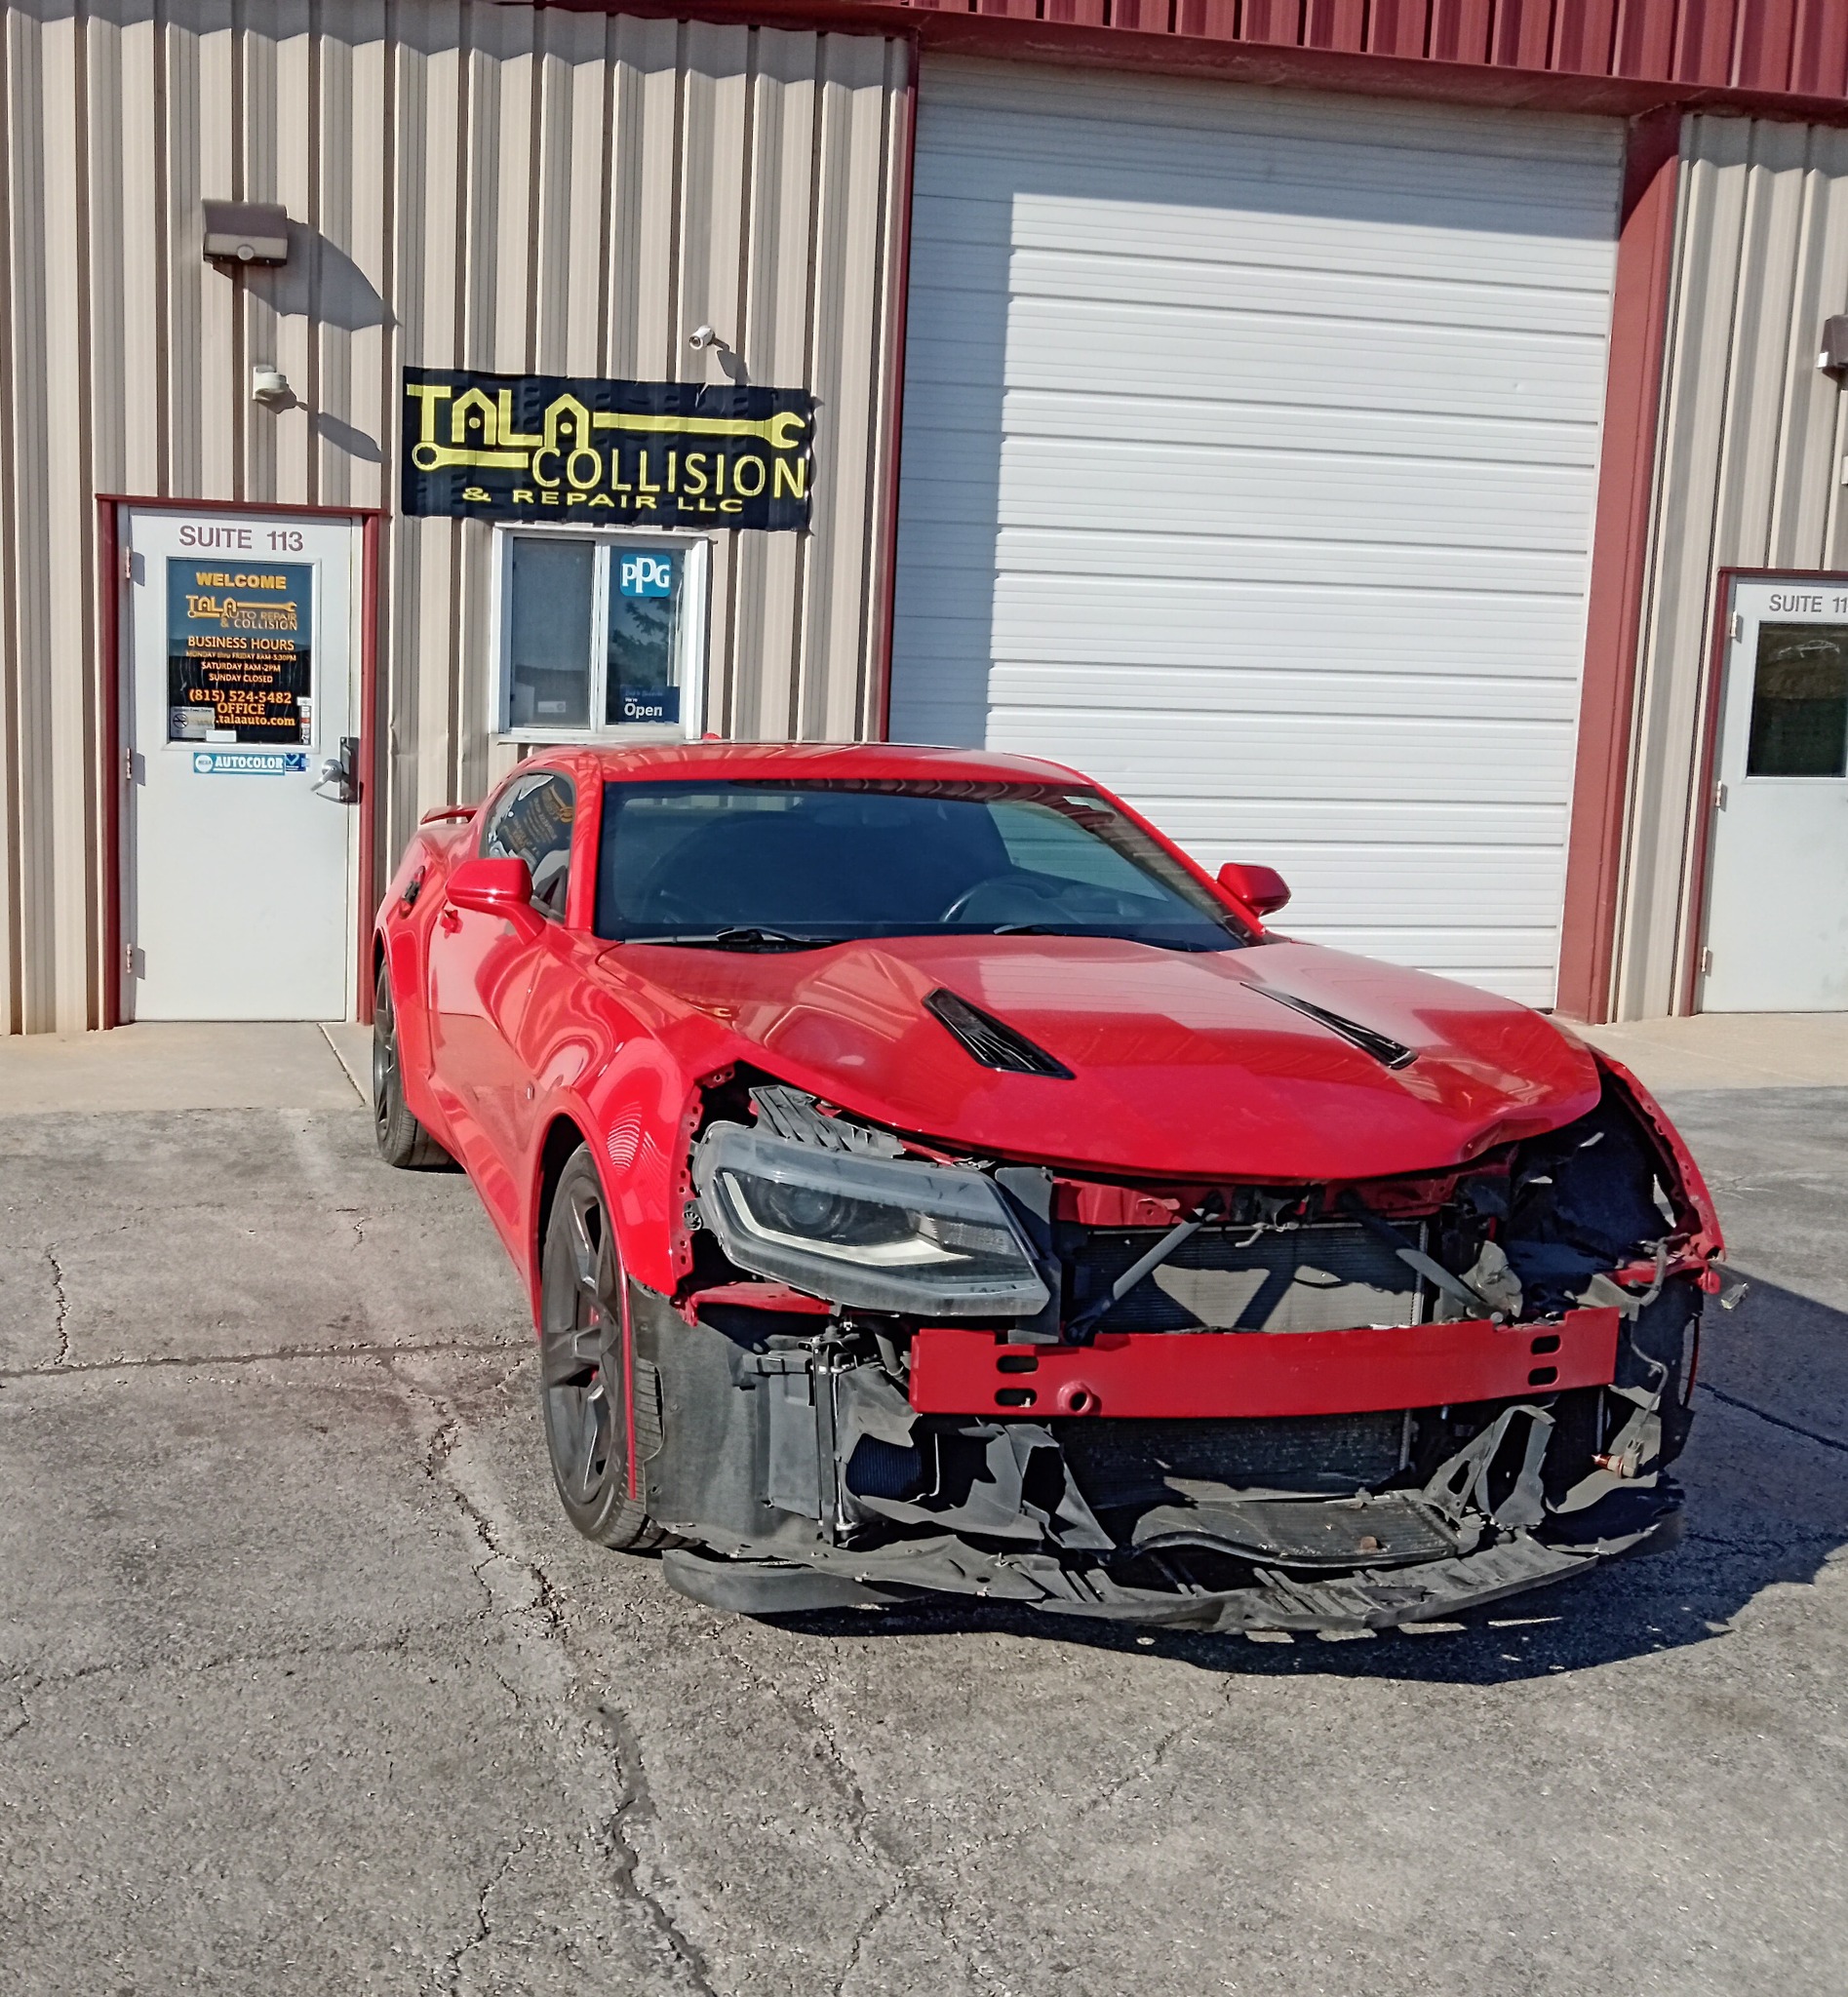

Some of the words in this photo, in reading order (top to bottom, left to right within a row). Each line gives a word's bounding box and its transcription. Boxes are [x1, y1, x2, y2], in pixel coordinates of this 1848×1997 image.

[406, 383, 590, 451] TALA
[531, 445, 806, 499] COLLISION
[461, 487, 491, 502] &
[512, 489, 657, 510] REPAIR
[677, 495, 744, 513] LLC
[178, 525, 253, 549] SUITE
[266, 529, 303, 552] 113
[195, 571, 287, 590] WELCOME
[621, 557, 670, 593] PPG
[185, 595, 237, 612] TALA
[1769, 593, 1823, 613] SUITE
[220, 616, 229, 628] &
[234, 619, 297, 631] COLLISION
[221, 610, 256, 619] AUTO
[260, 611, 297, 621] REPAIR
[187, 636, 247, 649] BUSINESS
[251, 638, 295, 651] HOURS
[232, 651, 255, 660] FRIDAY
[201, 661, 241, 671] SATURDAY
[244, 663, 281, 672] 8AM-2PM
[209, 673, 241, 682] SUNDAY
[243, 674, 273, 684] CLOSED
[189, 688, 225, 702] (815)
[229, 690, 292, 704] 524-5482
[216, 702, 265, 715] OFFICE
[624, 702, 663, 719] Open
[214, 714, 296, 726] .talaauto.com
[215, 755, 283, 769] AUTOCOLOR
